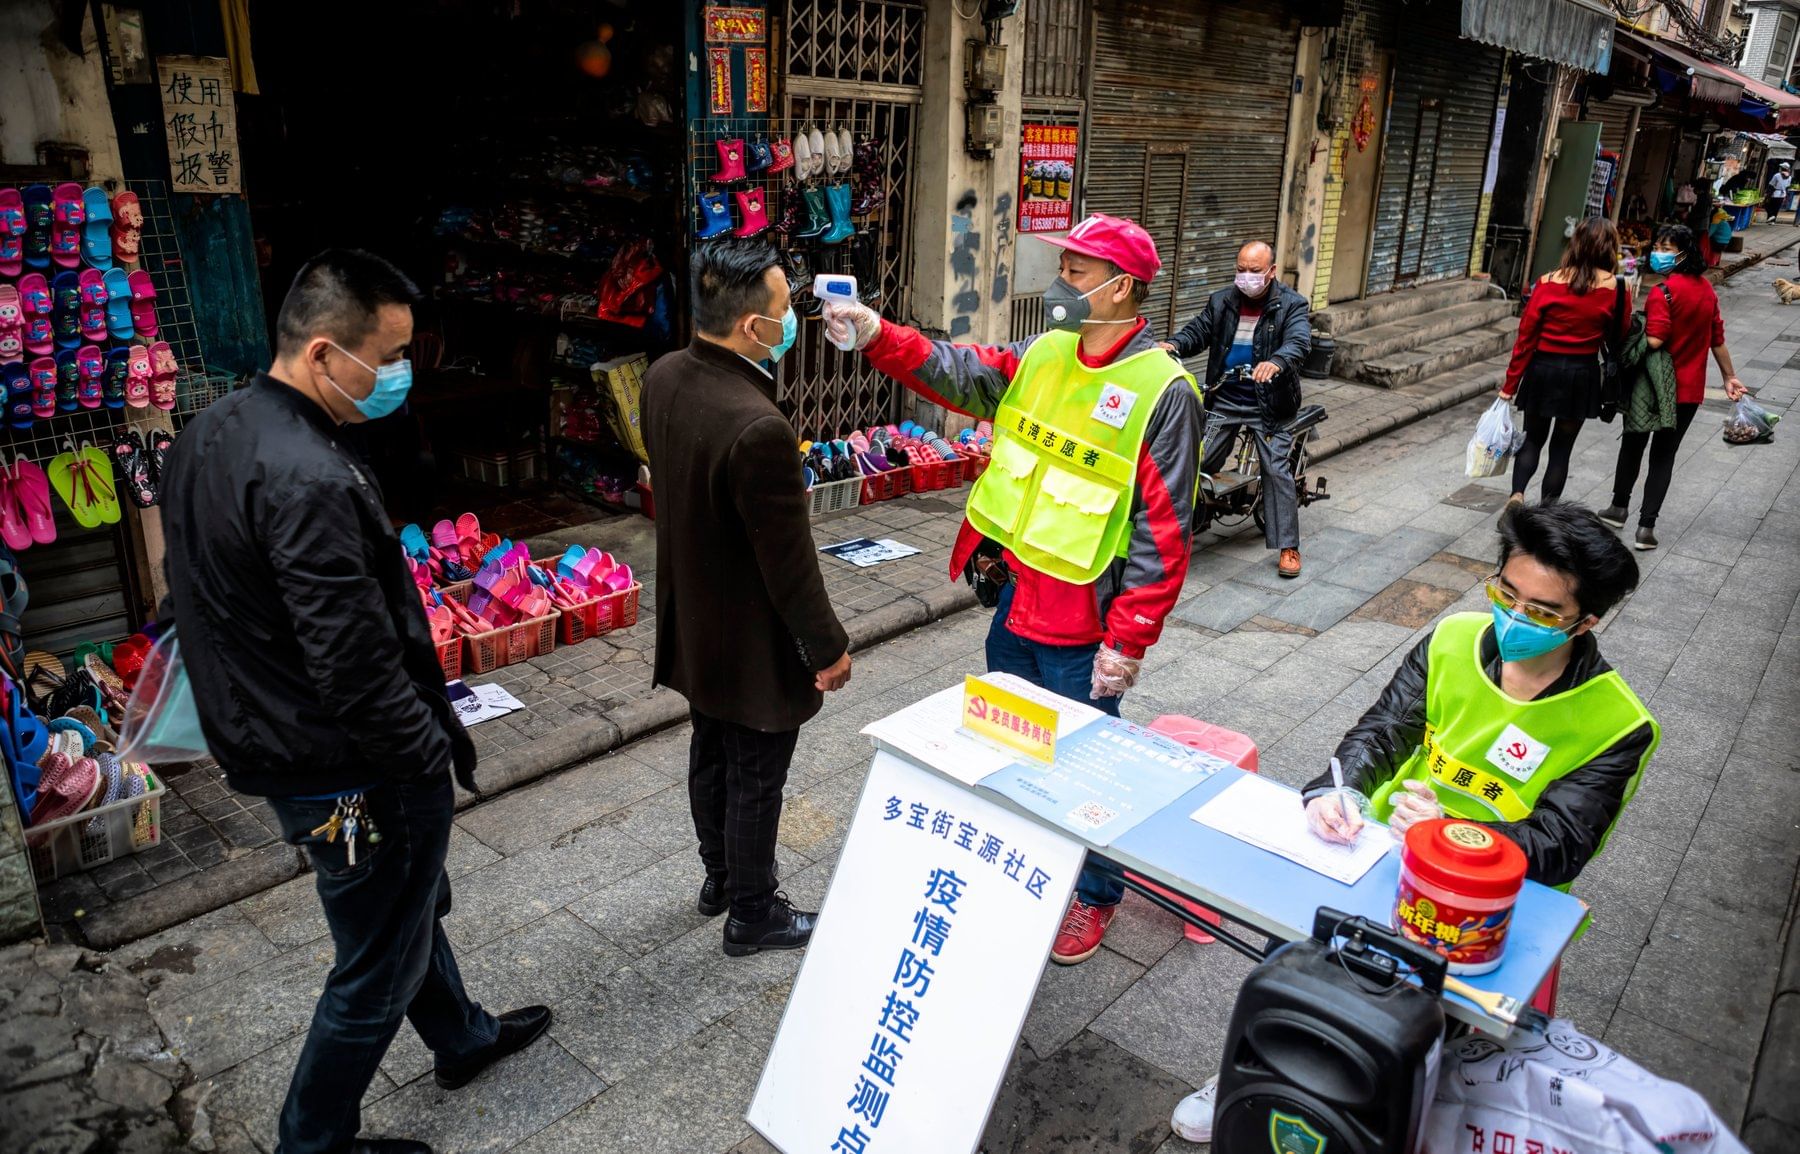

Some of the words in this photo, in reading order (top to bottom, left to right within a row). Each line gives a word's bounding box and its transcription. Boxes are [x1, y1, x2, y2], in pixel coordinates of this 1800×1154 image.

[166, 72, 221, 107] 使用
[1026, 127, 1077, 143] 客家黑糯米酒
[175, 150, 233, 186] 报警
[991, 707, 1051, 745] 党员服务岗位
[883, 795, 1052, 900] 多宝街宝源社区
[1397, 898, 1462, 945] 新年糖
